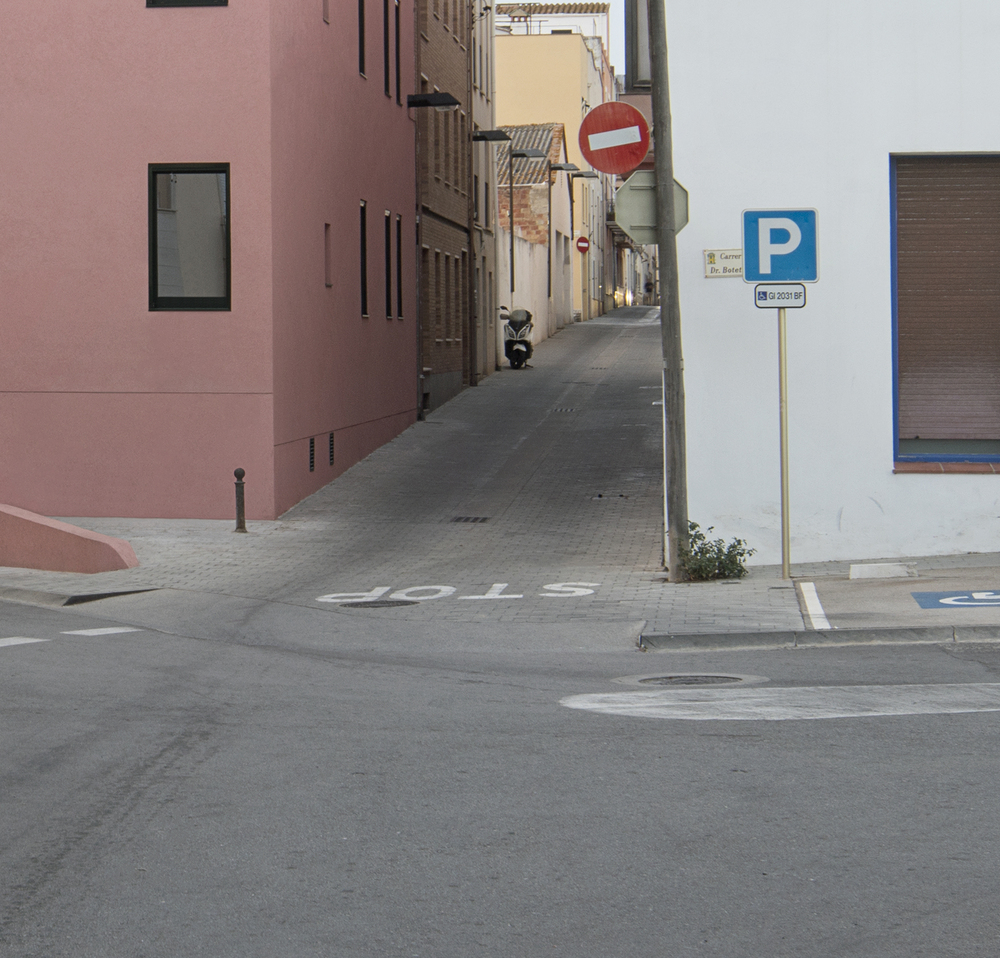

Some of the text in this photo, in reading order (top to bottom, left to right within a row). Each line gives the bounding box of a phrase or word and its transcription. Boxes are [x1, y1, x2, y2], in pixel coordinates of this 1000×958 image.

[758, 217, 802, 274] P
[720, 252, 742, 260] Carrer
[710, 266, 742, 274] Dr. Botet
[768, 291, 803, 300] GI 2031 BF
[315, 582, 600, 603] STOP
